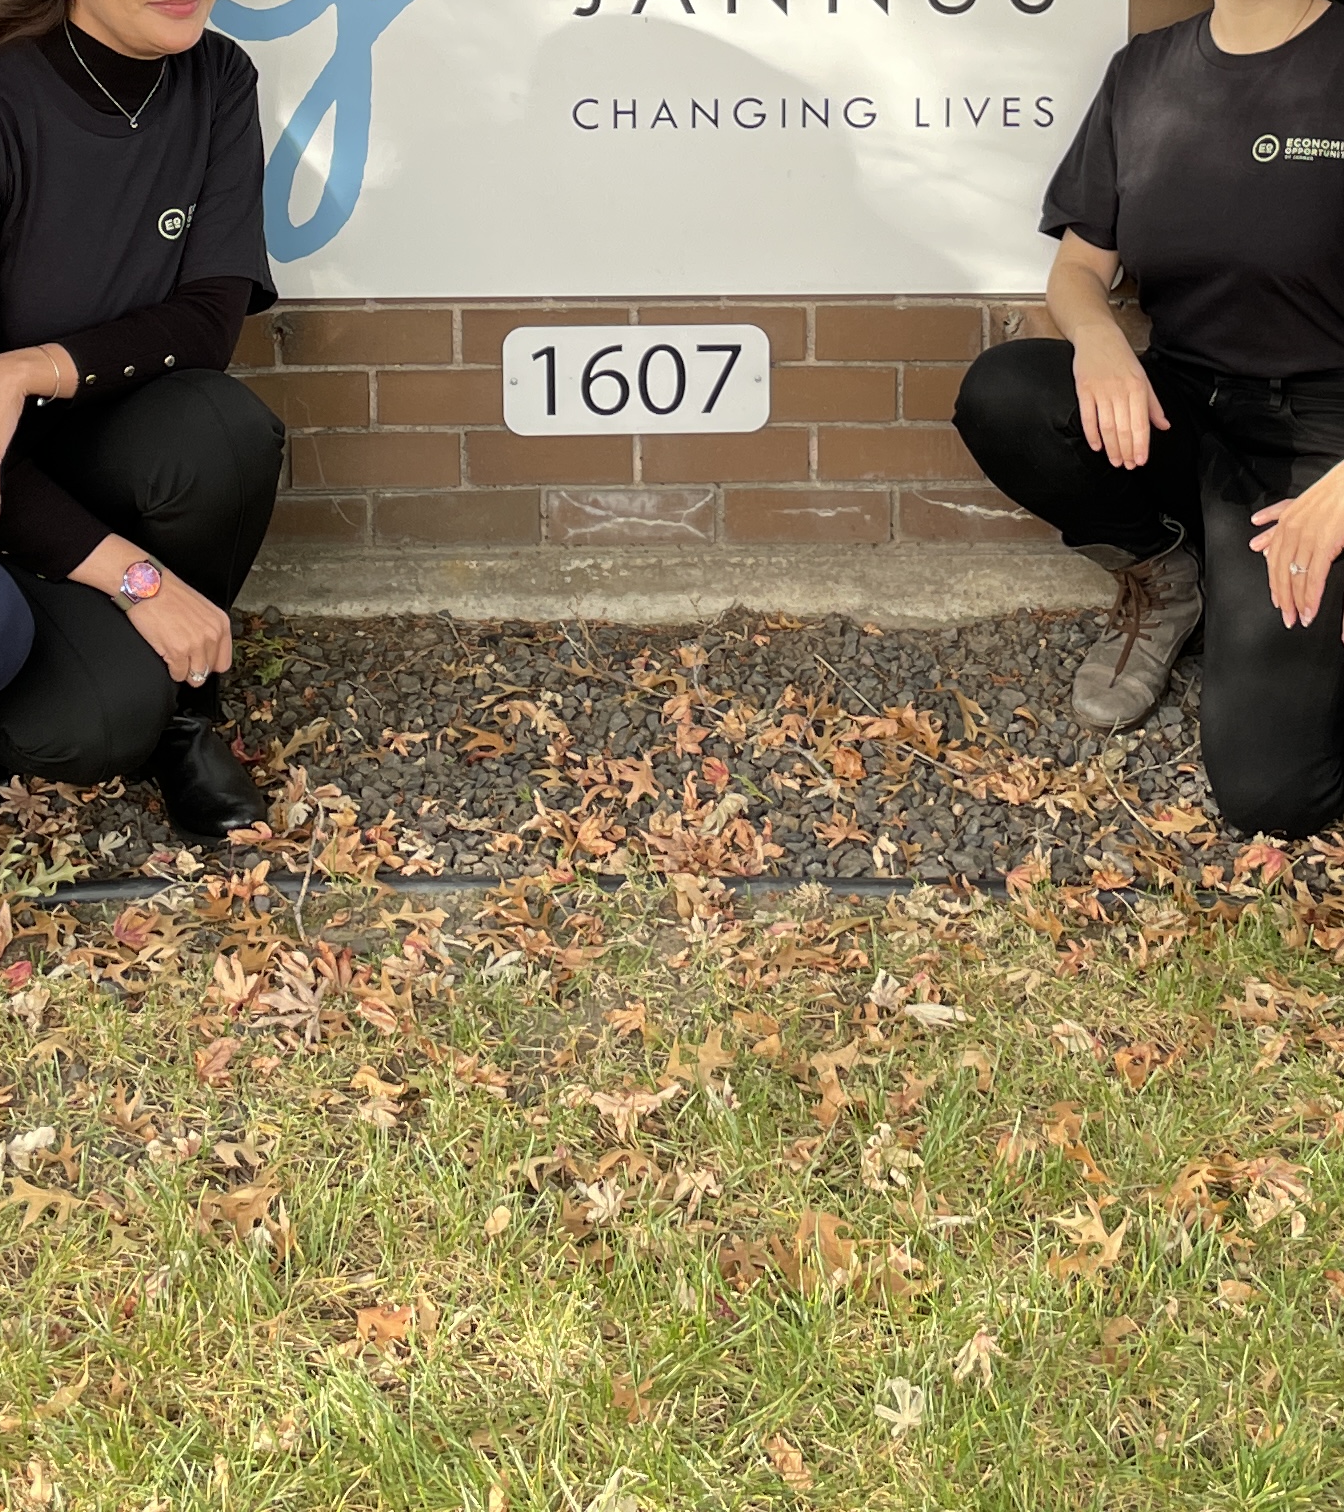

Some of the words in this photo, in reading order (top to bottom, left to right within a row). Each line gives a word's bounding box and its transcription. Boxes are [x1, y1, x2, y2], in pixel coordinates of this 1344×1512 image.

[571, 95, 881, 132] CHANGING
[915, 95, 1057, 130] LIVES
[531, 342, 743, 418] 1607
